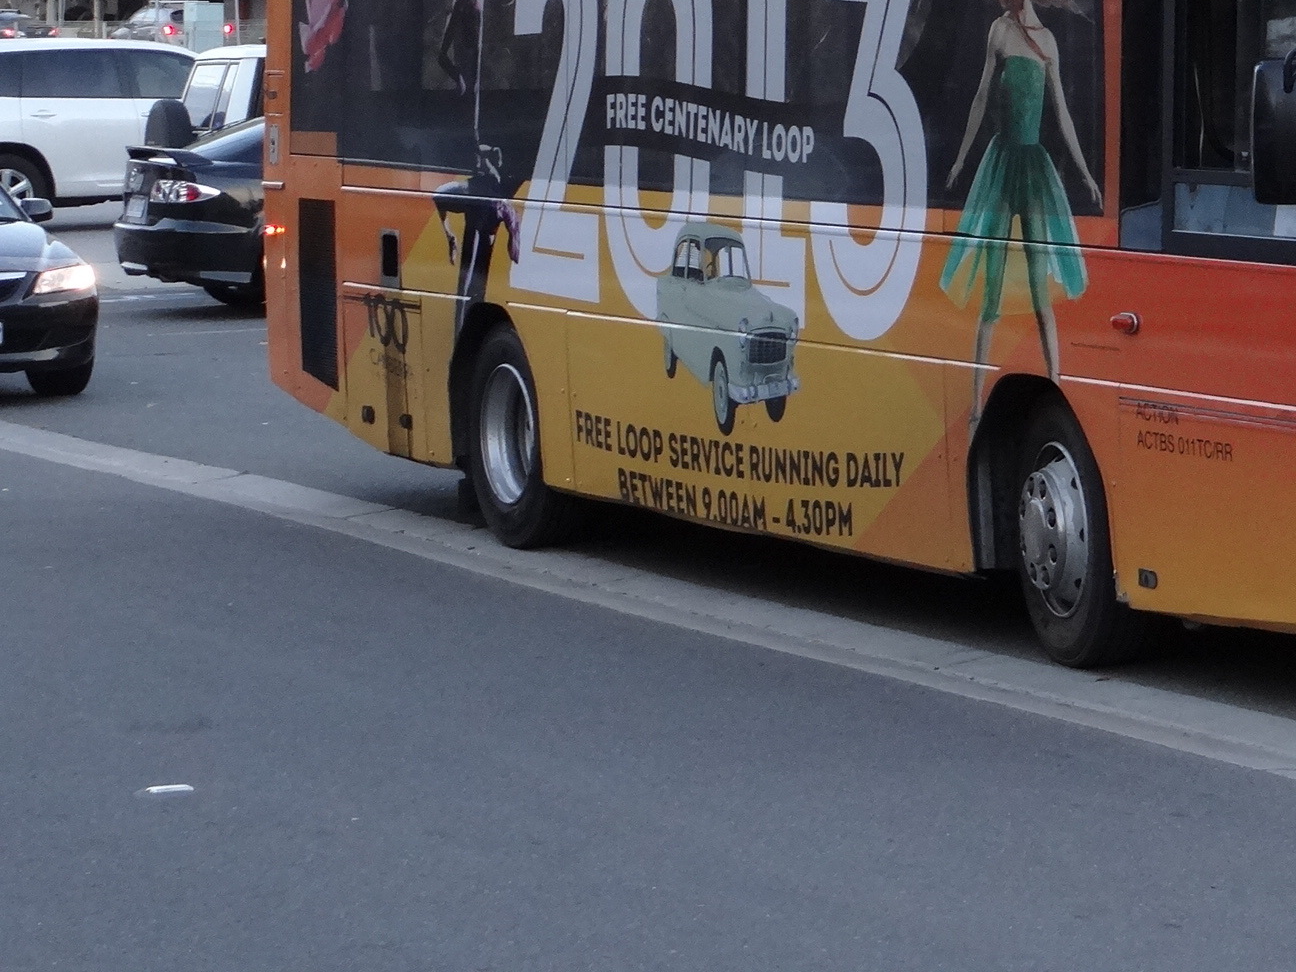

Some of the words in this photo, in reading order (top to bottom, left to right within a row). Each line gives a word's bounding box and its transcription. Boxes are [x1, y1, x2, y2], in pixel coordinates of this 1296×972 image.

[605, 92, 646, 131] FREE
[650, 96, 759, 155] CENTENARY
[761, 122, 815, 164] LOOP
[364, 293, 408, 354] 100
[1136, 402, 1180, 425] ACTION
[1137, 430, 1175, 454] ACTBS
[575, 409, 612, 451] FREE
[616, 420, 663, 463] LOOP
[668, 432, 745, 479] SERVICE
[749, 446, 839, 488] RUNNING
[846, 451, 905, 488] DAILY
[617, 467, 698, 516] BETWEEN
[702, 486, 768, 530] 9.00AM
[785, 498, 853, 537] 4.30PM
